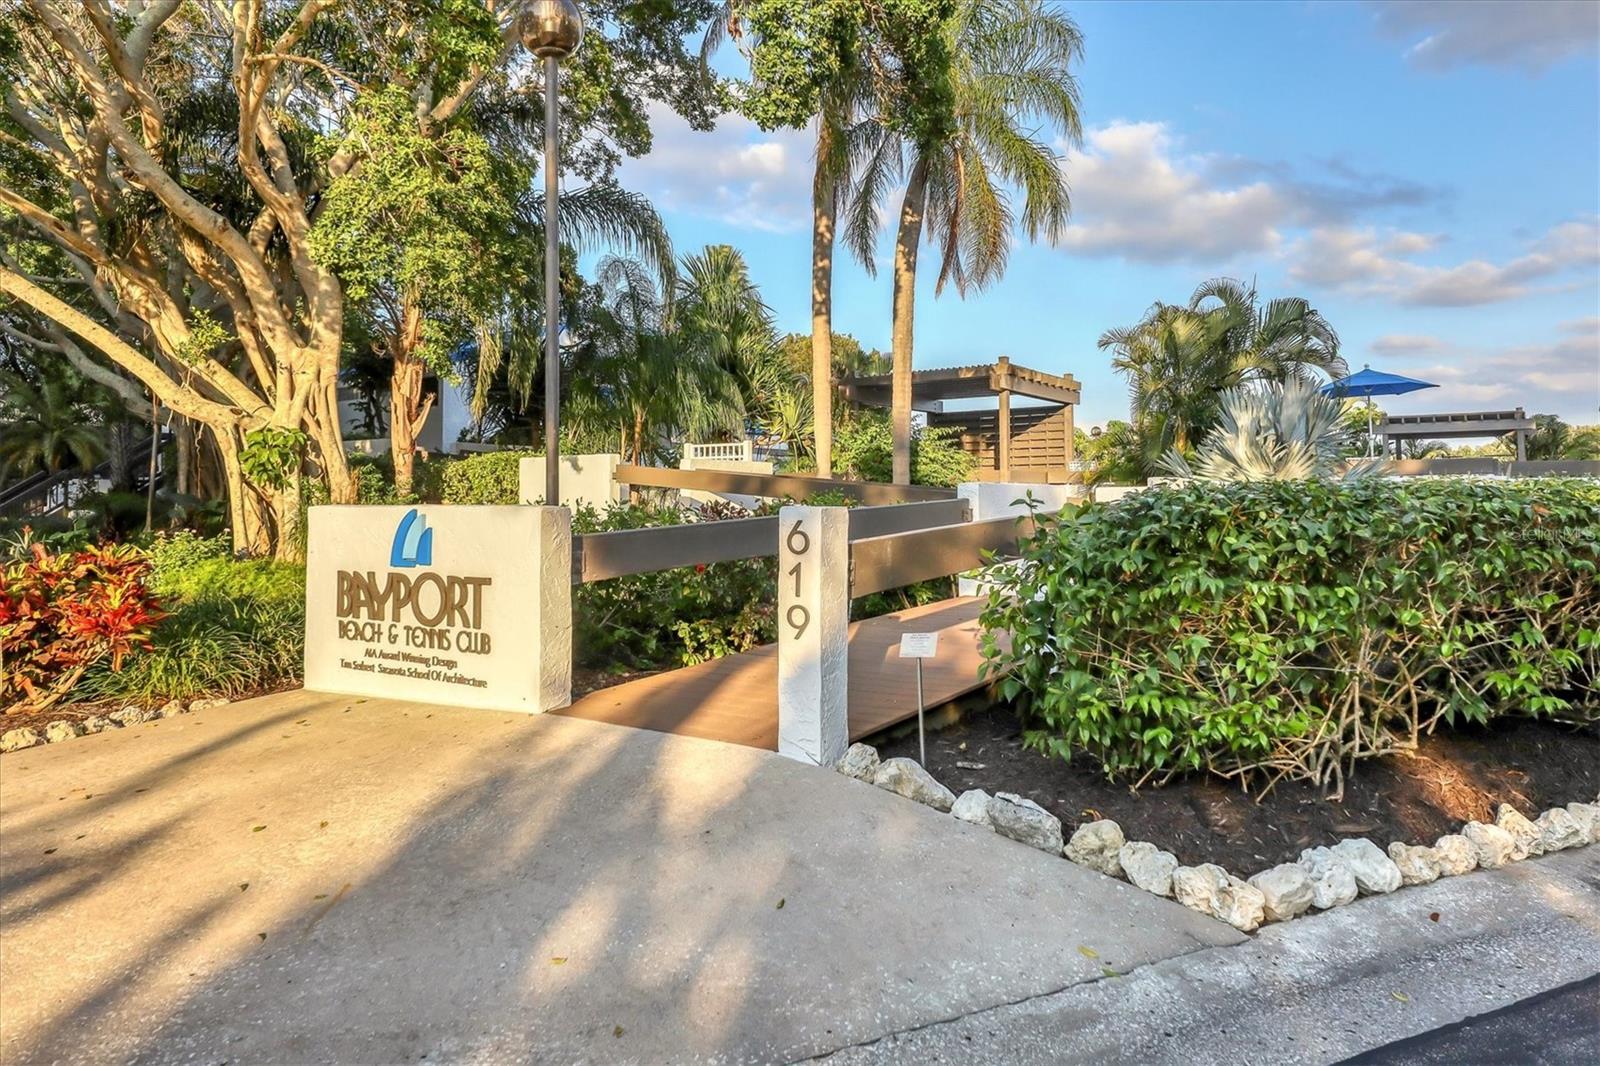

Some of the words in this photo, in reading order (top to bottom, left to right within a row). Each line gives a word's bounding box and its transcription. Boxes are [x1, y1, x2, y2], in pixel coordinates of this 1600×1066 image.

[787, 519, 810, 640] 619
[336, 570, 492, 629] BAYPORT
[338, 619, 383, 643] BEACH
[388, 623, 399, 644] &
[403, 625, 452, 650] TENNIS
[456, 630, 492, 655] CLUB
[378, 649, 401, 661] Award
[401, 651, 431, 668] Winning
[432, 656, 458, 670] Design
[378, 663, 406, 677] Sarasota
[407, 667, 431, 681] School
[431, 670, 442, 681] Of
[442, 672, 488, 689] Architecture
